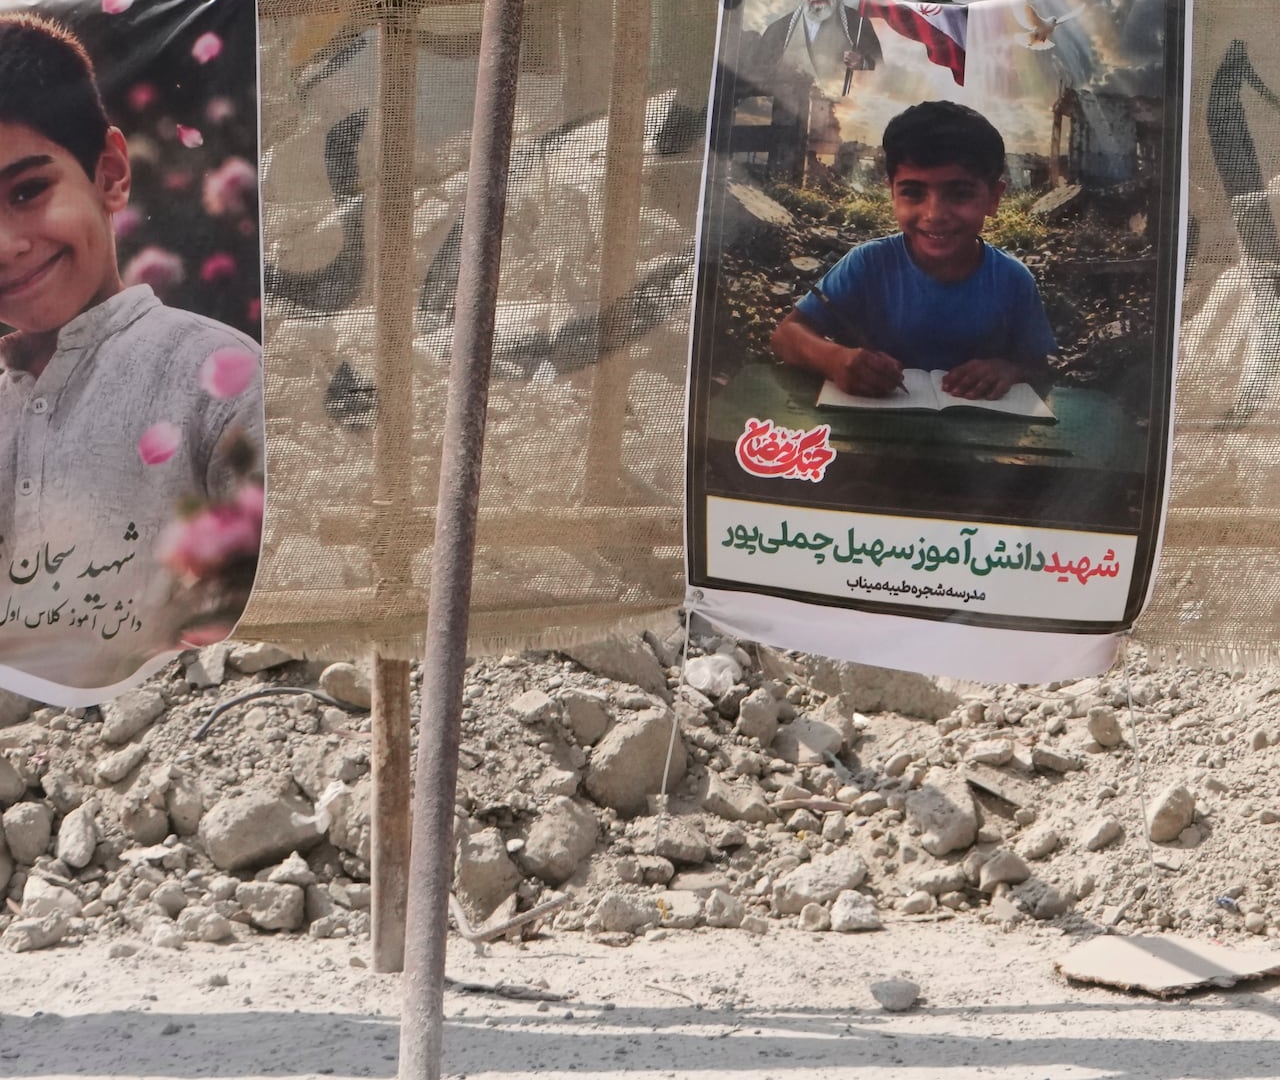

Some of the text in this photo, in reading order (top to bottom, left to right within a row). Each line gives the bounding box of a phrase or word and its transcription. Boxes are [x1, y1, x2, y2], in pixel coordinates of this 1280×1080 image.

[77, 522, 139, 603] شهید
[833, 528, 915, 567] سهیل
[1044, 549, 1120, 585] شهید
[847, 576, 986, 603] مدرسه شجره طیبه میناب
[25, 598, 69, 628] کلاس
